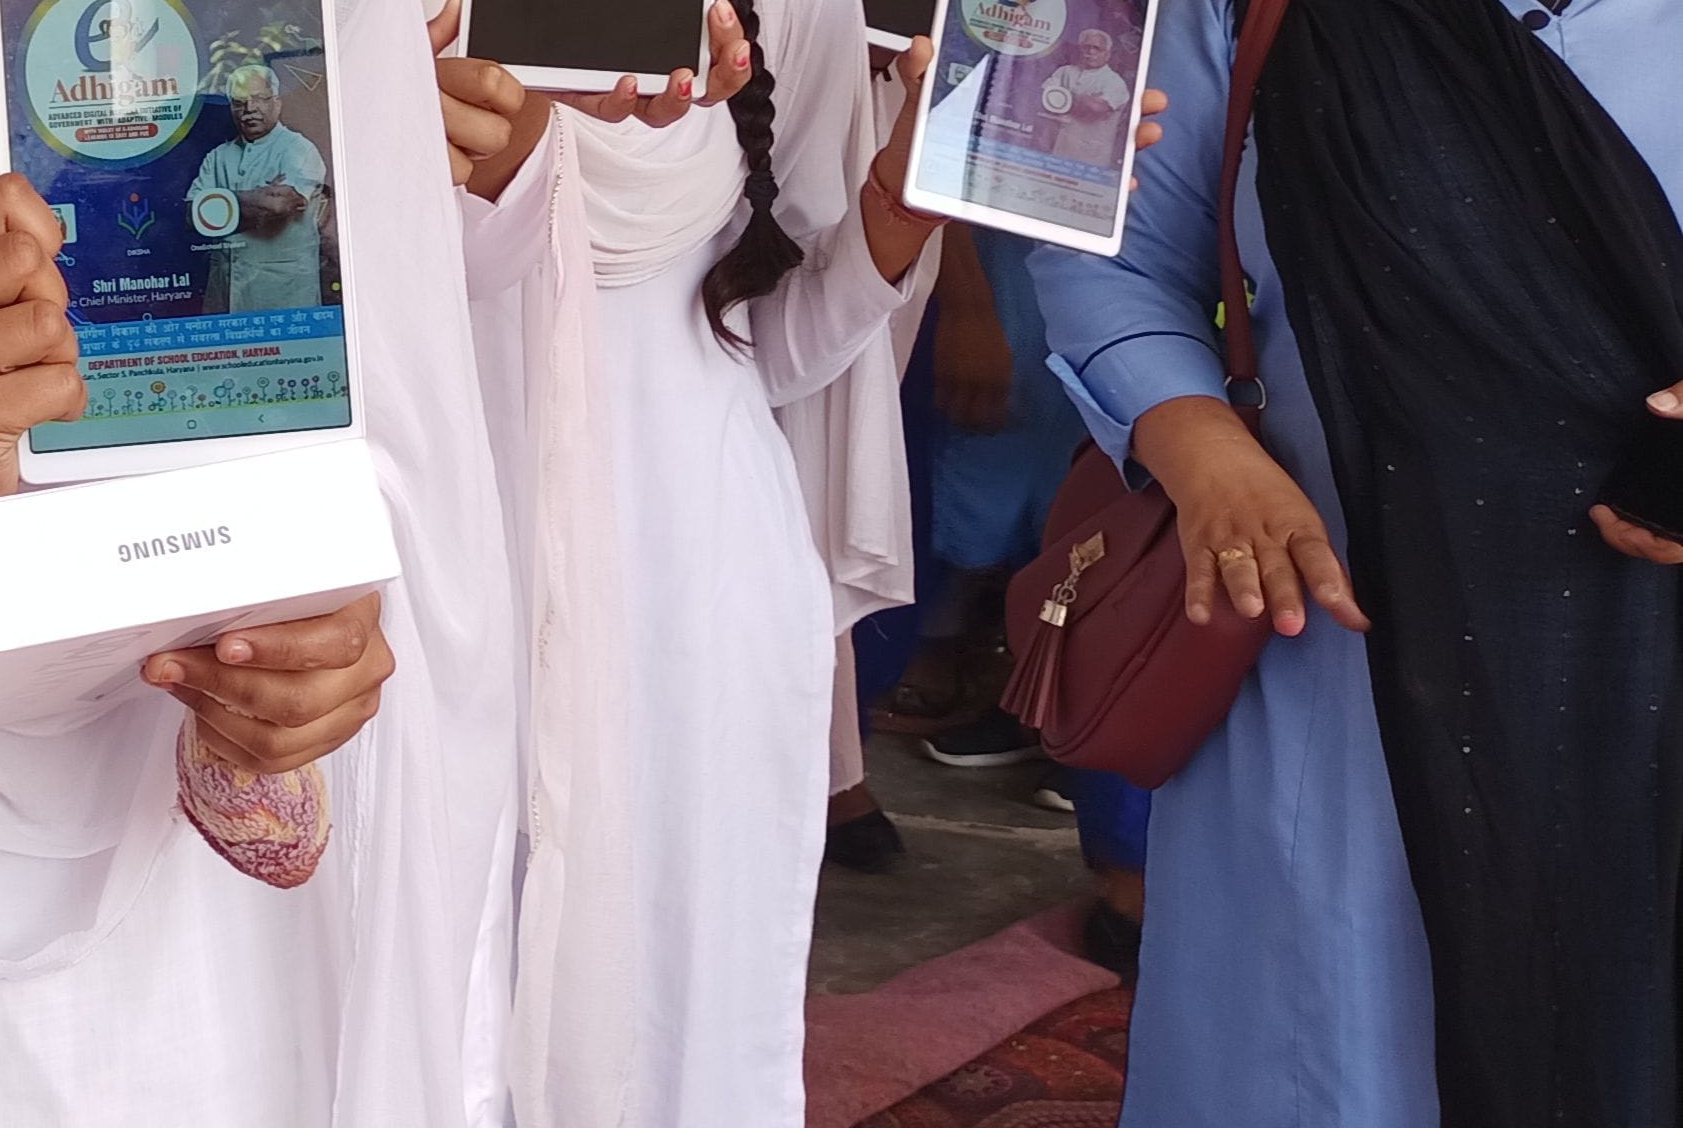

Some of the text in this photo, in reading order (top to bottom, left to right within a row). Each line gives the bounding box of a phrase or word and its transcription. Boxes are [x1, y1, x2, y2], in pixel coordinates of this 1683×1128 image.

[973, 1, 1052, 31] Adhigam
[93, 273, 190, 293] Shri Manohar Lal
[79, 296, 105, 307] Chief
[107, 294, 150, 305] Minister,
[151, 291, 193, 302] Haryana
[88, 346, 281, 370] DEPARTMENT OF SCHOOL EDUCATION, HARYANA
[117, 525, 232, 563] SAMSUNG
